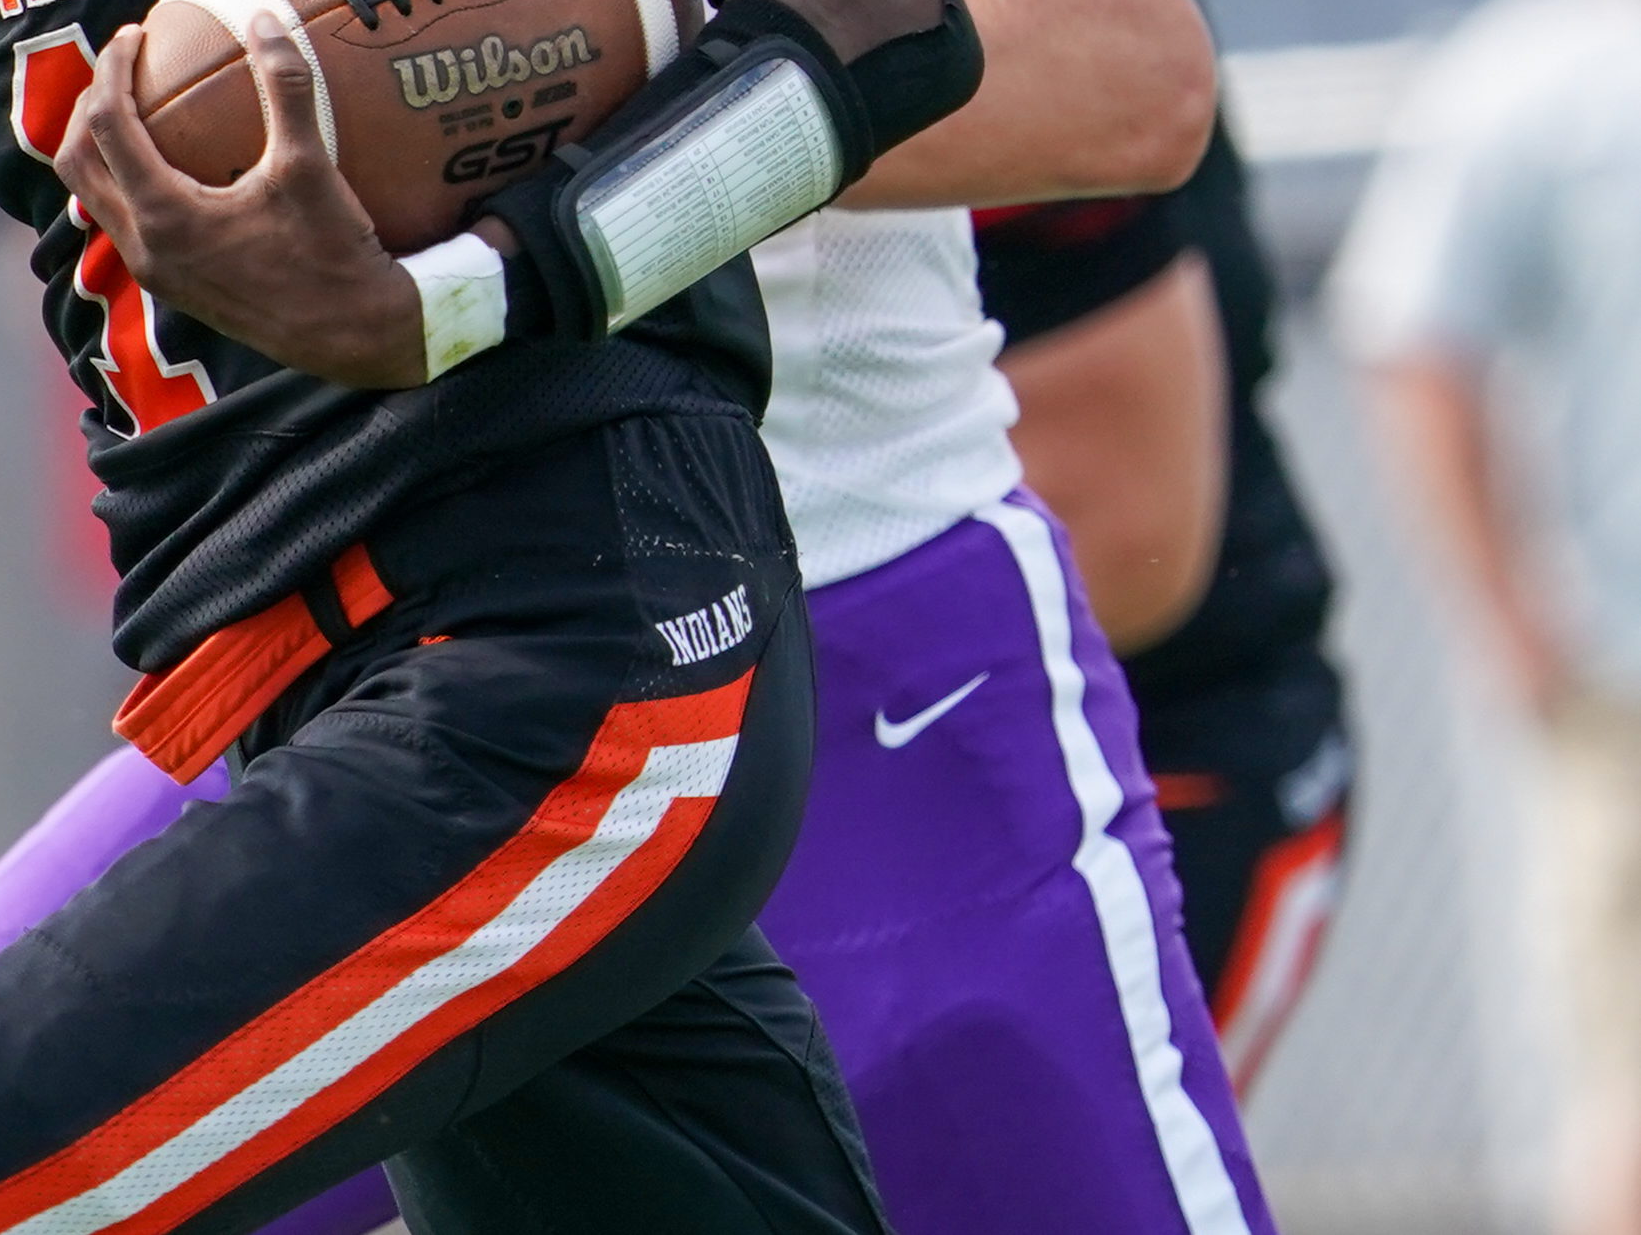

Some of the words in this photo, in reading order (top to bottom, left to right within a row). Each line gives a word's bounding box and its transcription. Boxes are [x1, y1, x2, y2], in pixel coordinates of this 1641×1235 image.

[391, 28, 592, 108] Wilson
[443, 115, 574, 184] GST
[655, 584, 753, 666] INDIANS
